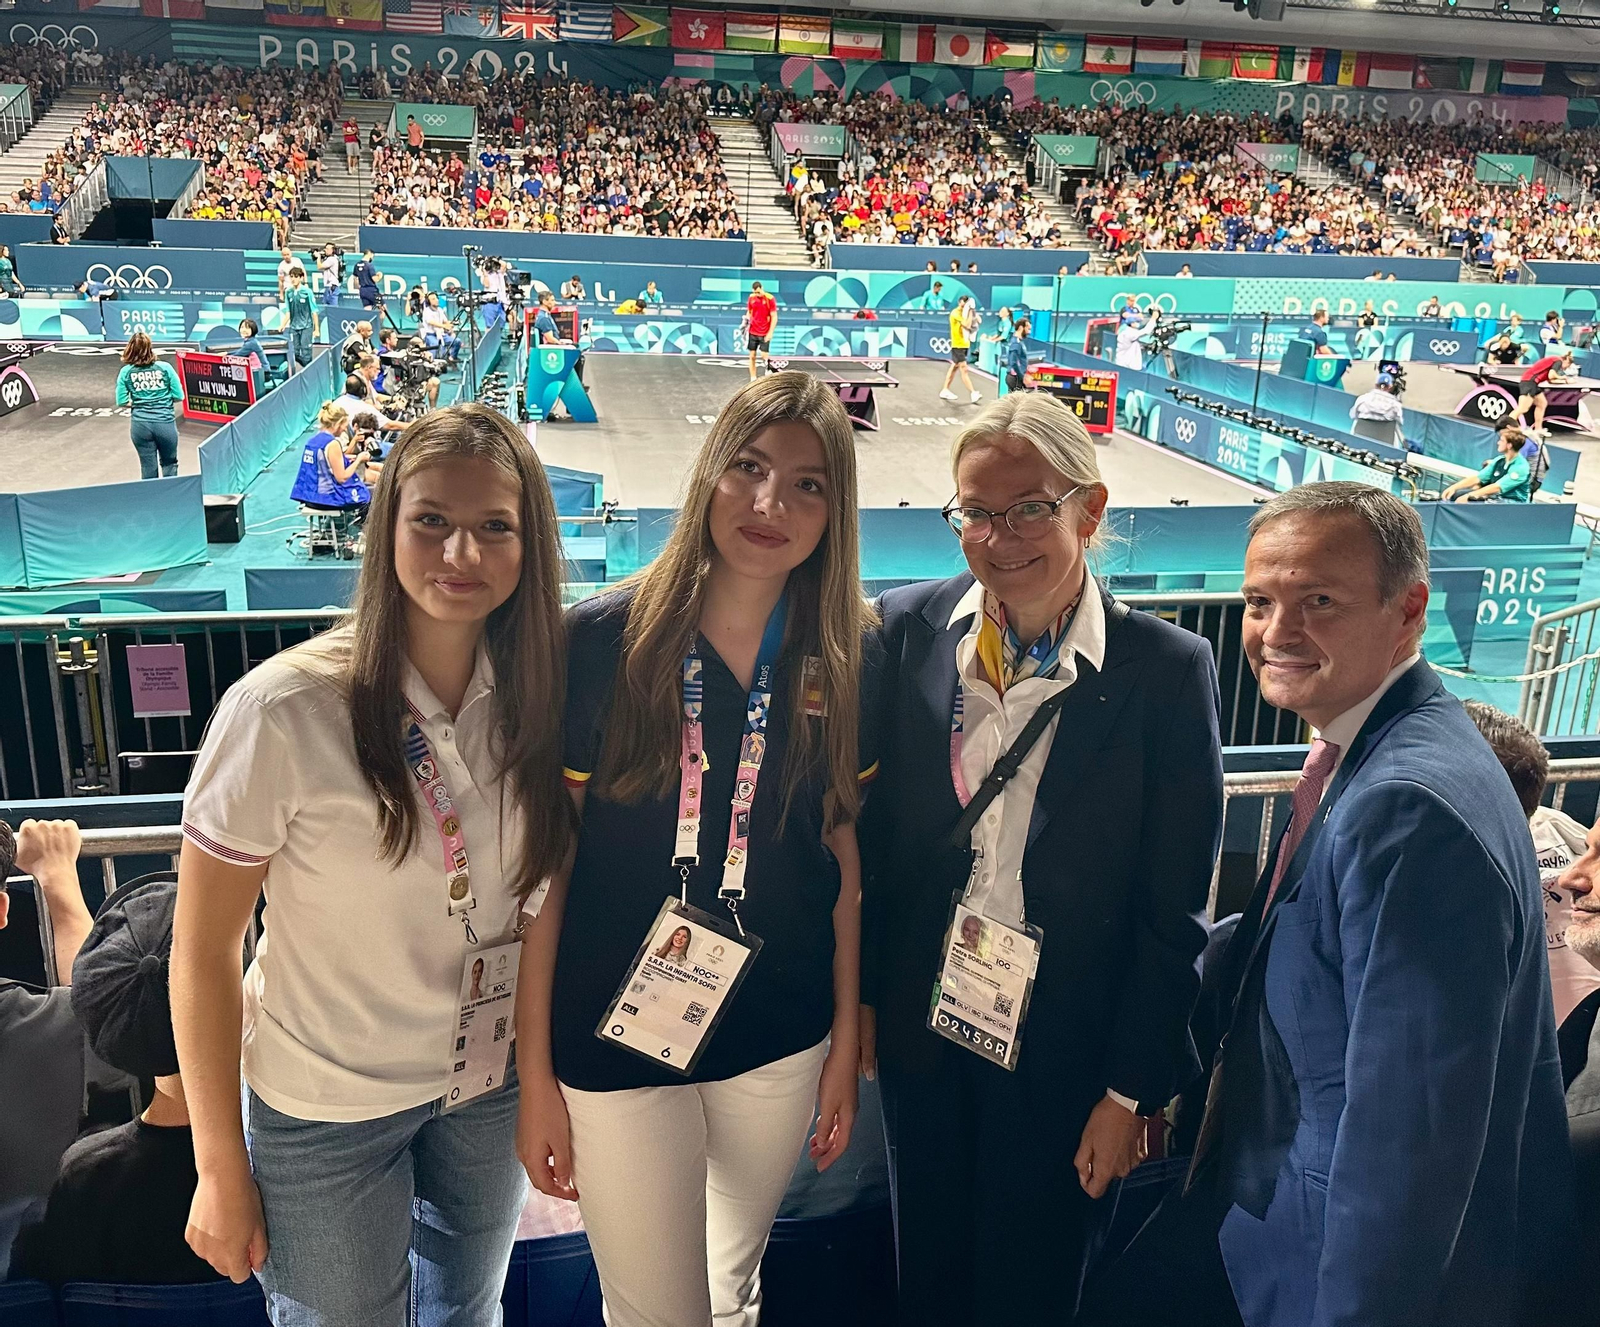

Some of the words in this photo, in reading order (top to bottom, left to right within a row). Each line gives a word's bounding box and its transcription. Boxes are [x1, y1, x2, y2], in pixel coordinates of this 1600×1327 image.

[121, 310, 166, 323] PARIS
[123, 323, 167, 336] 2024
[130, 370, 163, 382] PARIS
[185, 361, 212, 376] WINNER
[219, 366, 232, 378] TPE
[133, 380, 164, 391] 2024
[199, 381, 211, 394] LIN
[211, 382, 237, 397] YUN-JU
[1076, 401, 1084, 416] 8
[1216, 445, 1248, 472] 2024
[952, 946, 967, 958] Petra
[996, 957, 1011, 970] IOC
[665, 964, 673, 972] LA
[673, 967, 699, 983] INFANTA
[698, 979, 717, 991] SOFIA
[494, 983, 505, 991] NOC
[623, 1004, 636, 1015] ALL
[661, 1047, 671, 1058] 6
[485, 1074, 493, 1087] 6
